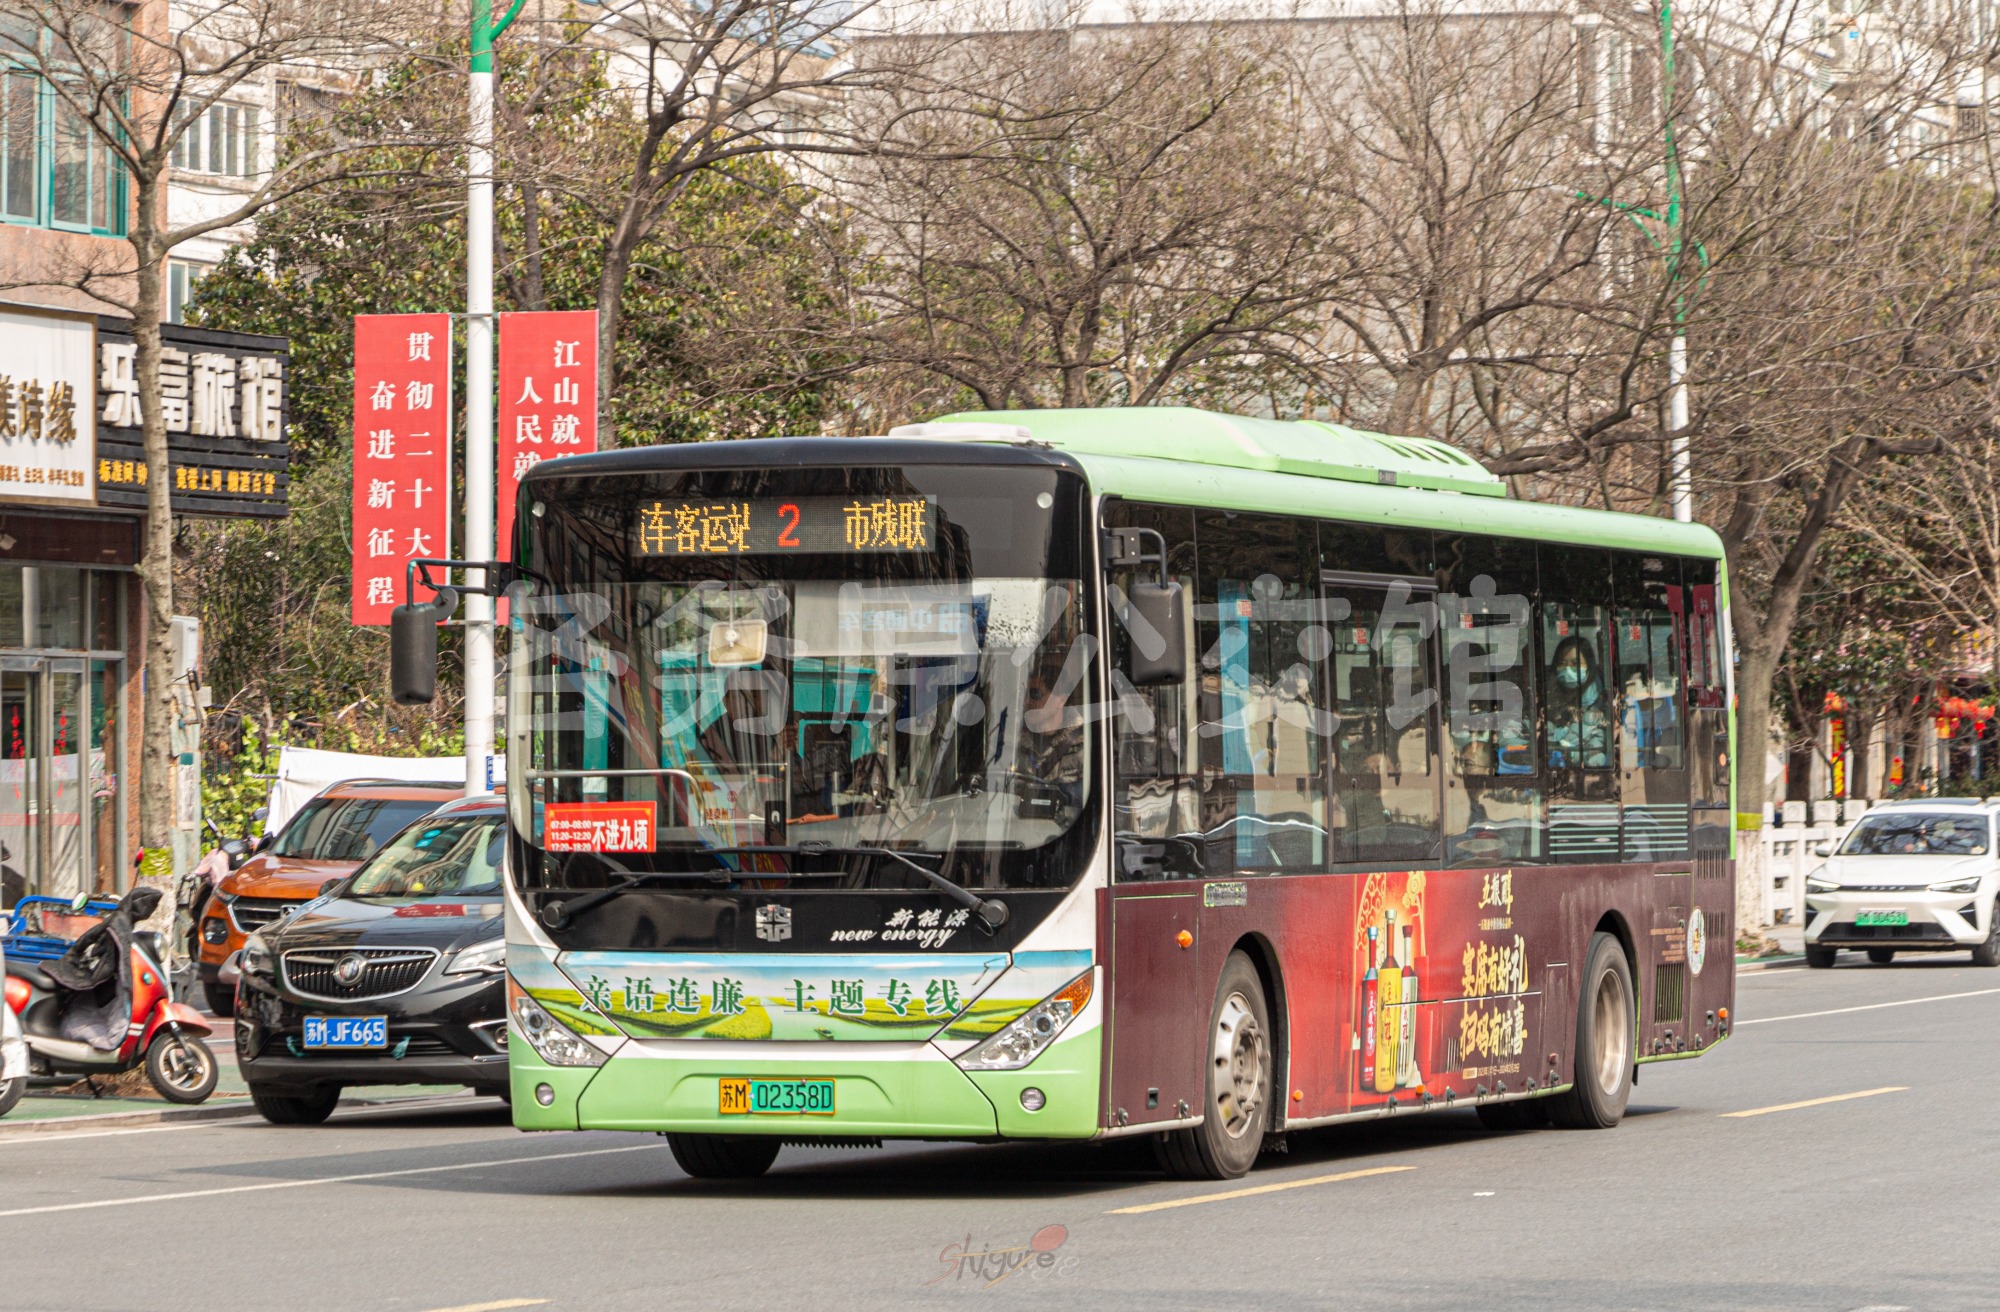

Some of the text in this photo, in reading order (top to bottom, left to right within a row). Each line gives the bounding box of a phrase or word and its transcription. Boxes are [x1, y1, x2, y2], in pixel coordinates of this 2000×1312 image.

[551, 340, 581, 458] 江山就
[406, 332, 435, 557] 贯彻二十大
[366, 380, 397, 606] 奋进新征程
[640, 499, 927, 553] 车客运站 2 市残联
[592, 818, 649, 851] 不进九顷
[830, 927, 957, 949] new energy
[885, 908, 970, 927] 新能源
[580, 974, 965, 1017] 亲语连廉 主题专线
[1461, 933, 1529, 1009] 宴席有好礼
[1459, 999, 1528, 1062] 扫码有惊喜
